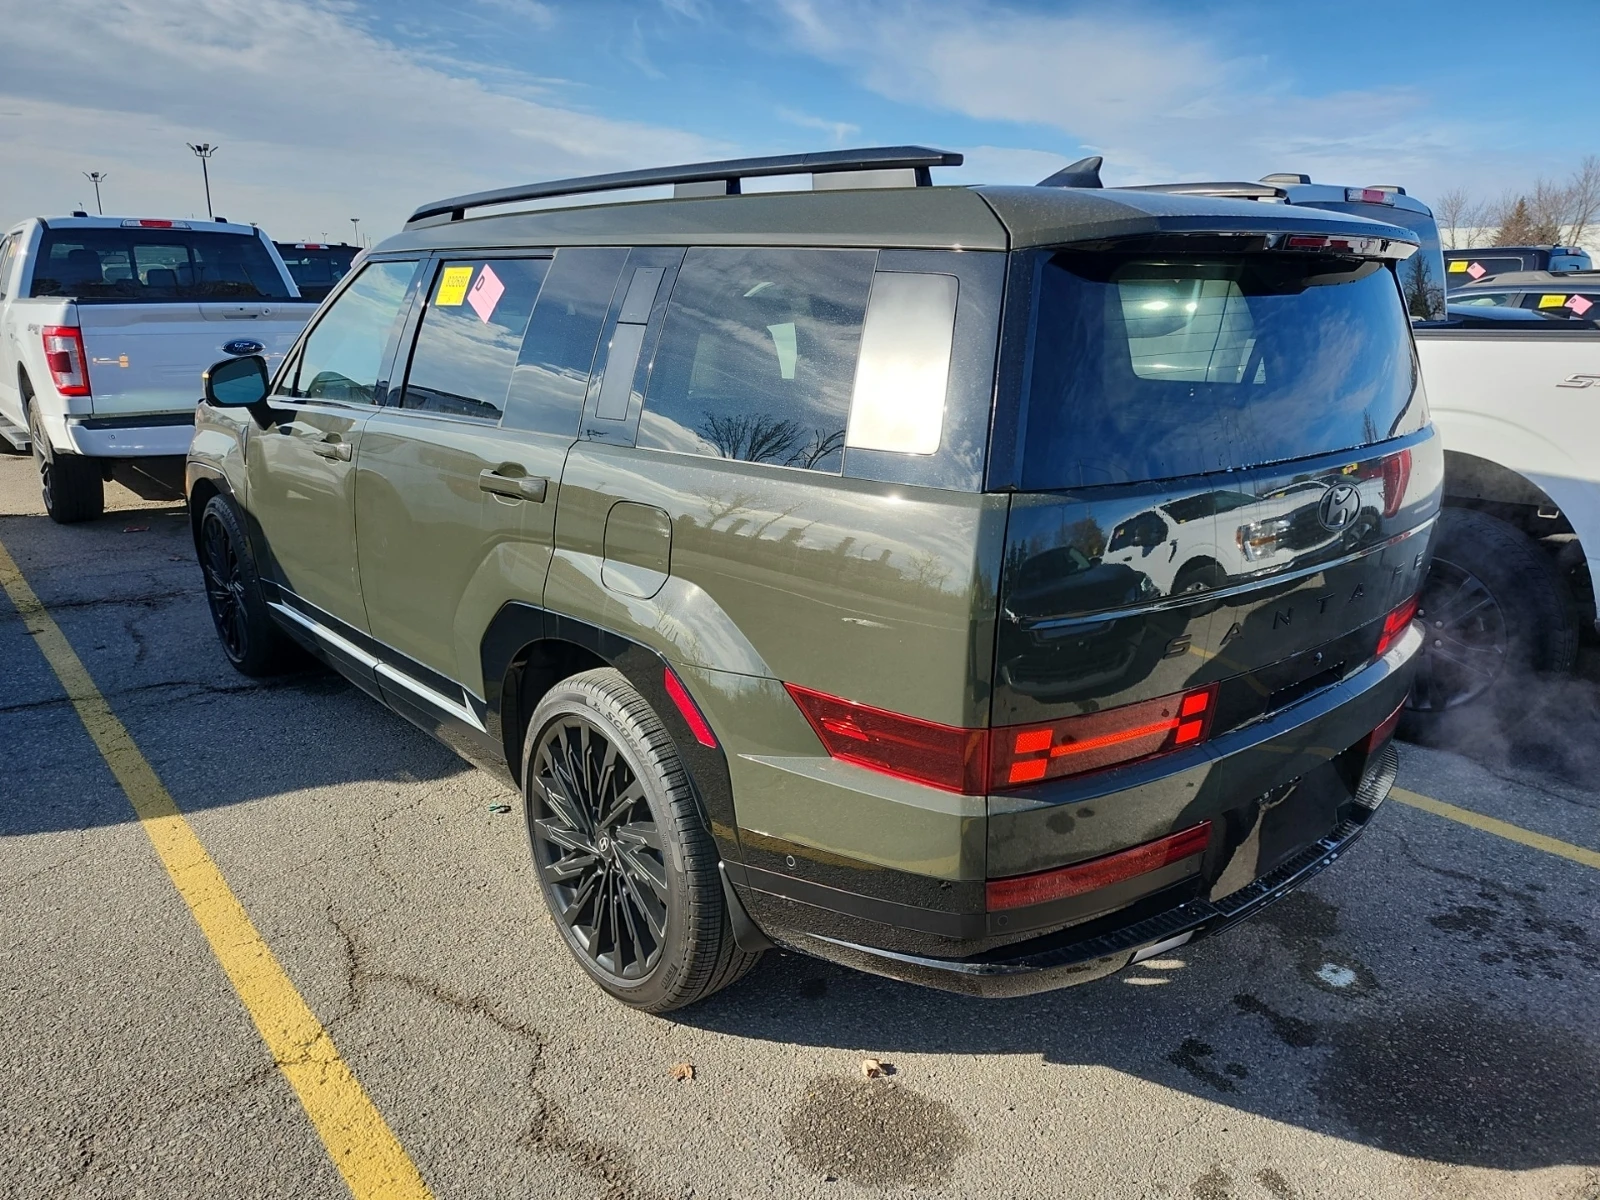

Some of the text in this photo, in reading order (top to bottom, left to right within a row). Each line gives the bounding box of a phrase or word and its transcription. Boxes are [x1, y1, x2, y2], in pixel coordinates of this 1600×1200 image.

[475, 275, 486, 291] D
[1163, 550, 1425, 660] SANTA FE
